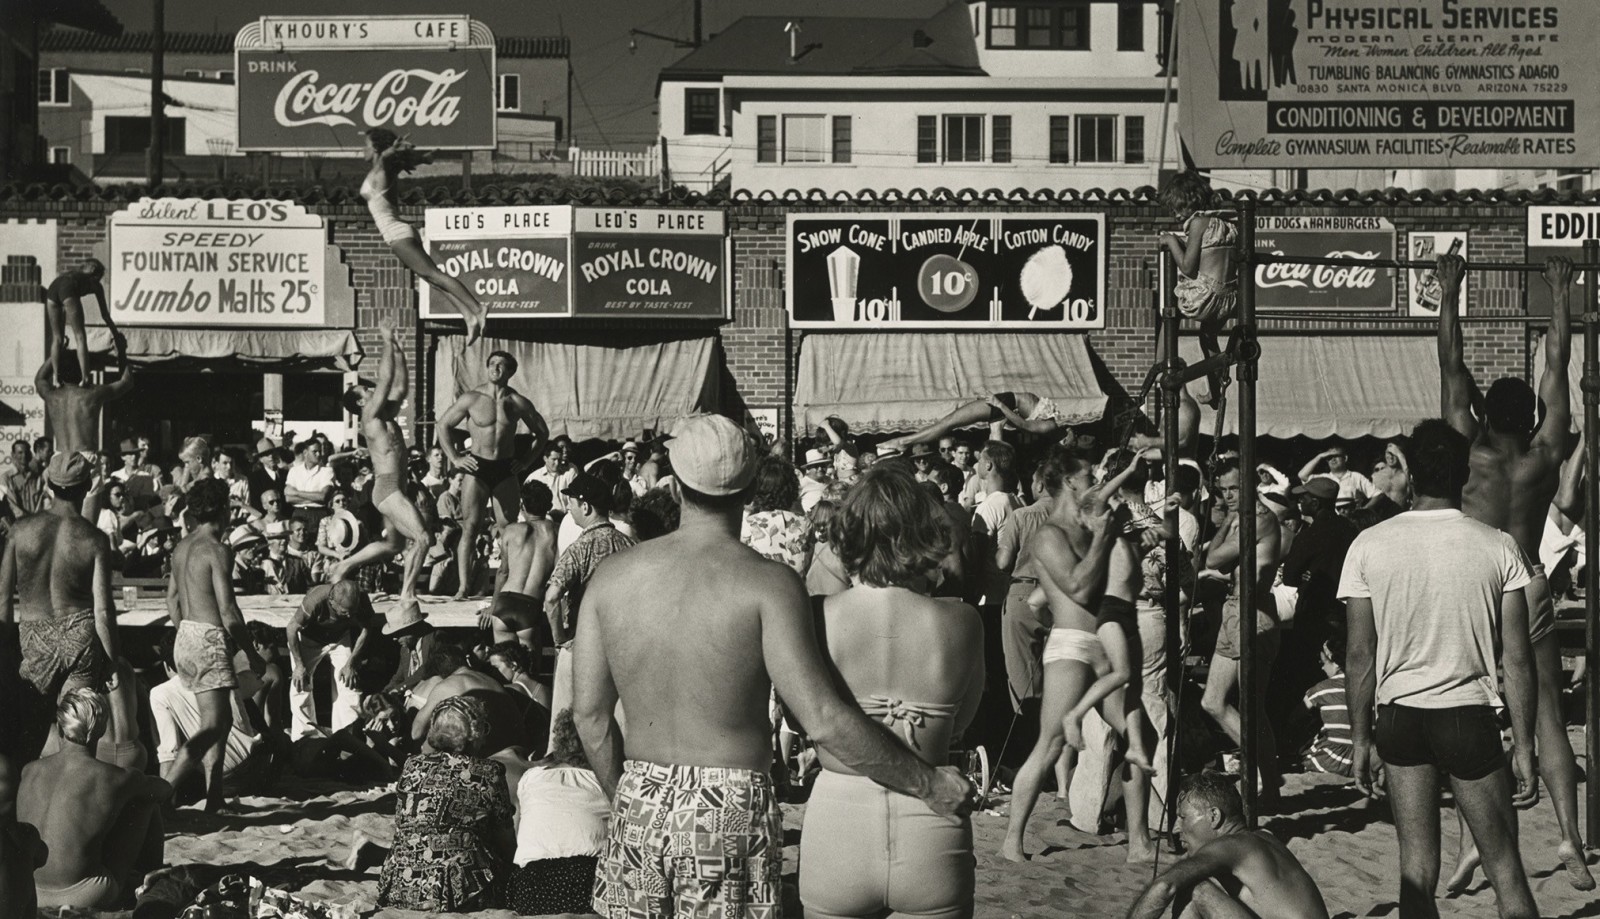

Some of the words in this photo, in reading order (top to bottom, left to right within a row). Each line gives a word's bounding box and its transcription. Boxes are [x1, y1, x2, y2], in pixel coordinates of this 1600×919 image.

[1307, 0, 1433, 30] PHYSICAL
[1443, 0, 1559, 30] SERVICES
[275, 23, 368, 39] KHOURY'S
[414, 22, 459, 38] CAFE
[1423, 35, 1483, 43] CLEAN
[1511, 34, 1559, 42] SAFE
[1322, 45, 1360, 57] Men
[1362, 44, 1409, 57] Women
[1414, 43, 1478, 57] Children
[1480, 43, 1507, 57] All
[1507, 43, 1543, 61] Ages
[247, 61, 298, 72] DRINK
[1308, 65, 1370, 80] TUMBLING
[1376, 65, 1440, 80] BALANCING
[1445, 65, 1515, 80] GYMNASTICS
[1518, 64, 1560, 80] ADAGIO
[1297, 84, 1329, 93] 10830
[1336, 84, 1370, 93] SANTA
[1376, 83, 1428, 93] MONICA
[1477, 83, 1528, 93] ARIZONA
[1533, 83, 1568, 93] 75229
[274, 68, 469, 127] Coca-Cola
[1275, 107, 1402, 127] CONDITIONING
[1412, 107, 1426, 129] &
[1438, 106, 1567, 127] DEVELOPMENT
[1215, 130, 1281, 163] Complete
[1285, 139, 1371, 156] GYMNASIUM
[1523, 138, 1576, 154] RATES
[207, 202, 288, 222] LEO'S
[446, 211, 484, 229] LEO'S
[504, 212, 550, 228] PLACE
[595, 210, 637, 228] LEO'S
[657, 213, 704, 230] PLACE
[1274, 217, 1301, 229] DOGS
[1310, 217, 1381, 229] HAMBURGERS
[162, 232, 264, 247] SPEEDY
[439, 243, 468, 251] DRINK
[121, 251, 218, 272] FOUNTAIN
[227, 252, 309, 273] SERVICE
[497, 246, 564, 283] CROWN
[581, 248, 645, 283] ROYAL
[648, 247, 717, 284] CROWN
[475, 278, 519, 295] COLA
[626, 278, 672, 295] COLA
[114, 277, 211, 313] Jumbo
[218, 278, 275, 314] Malts
[491, 301, 540, 309] TASTE-TEST
[643, 301, 693, 309] TASTE-TEST
[0, 380, 38, 396] oxca
